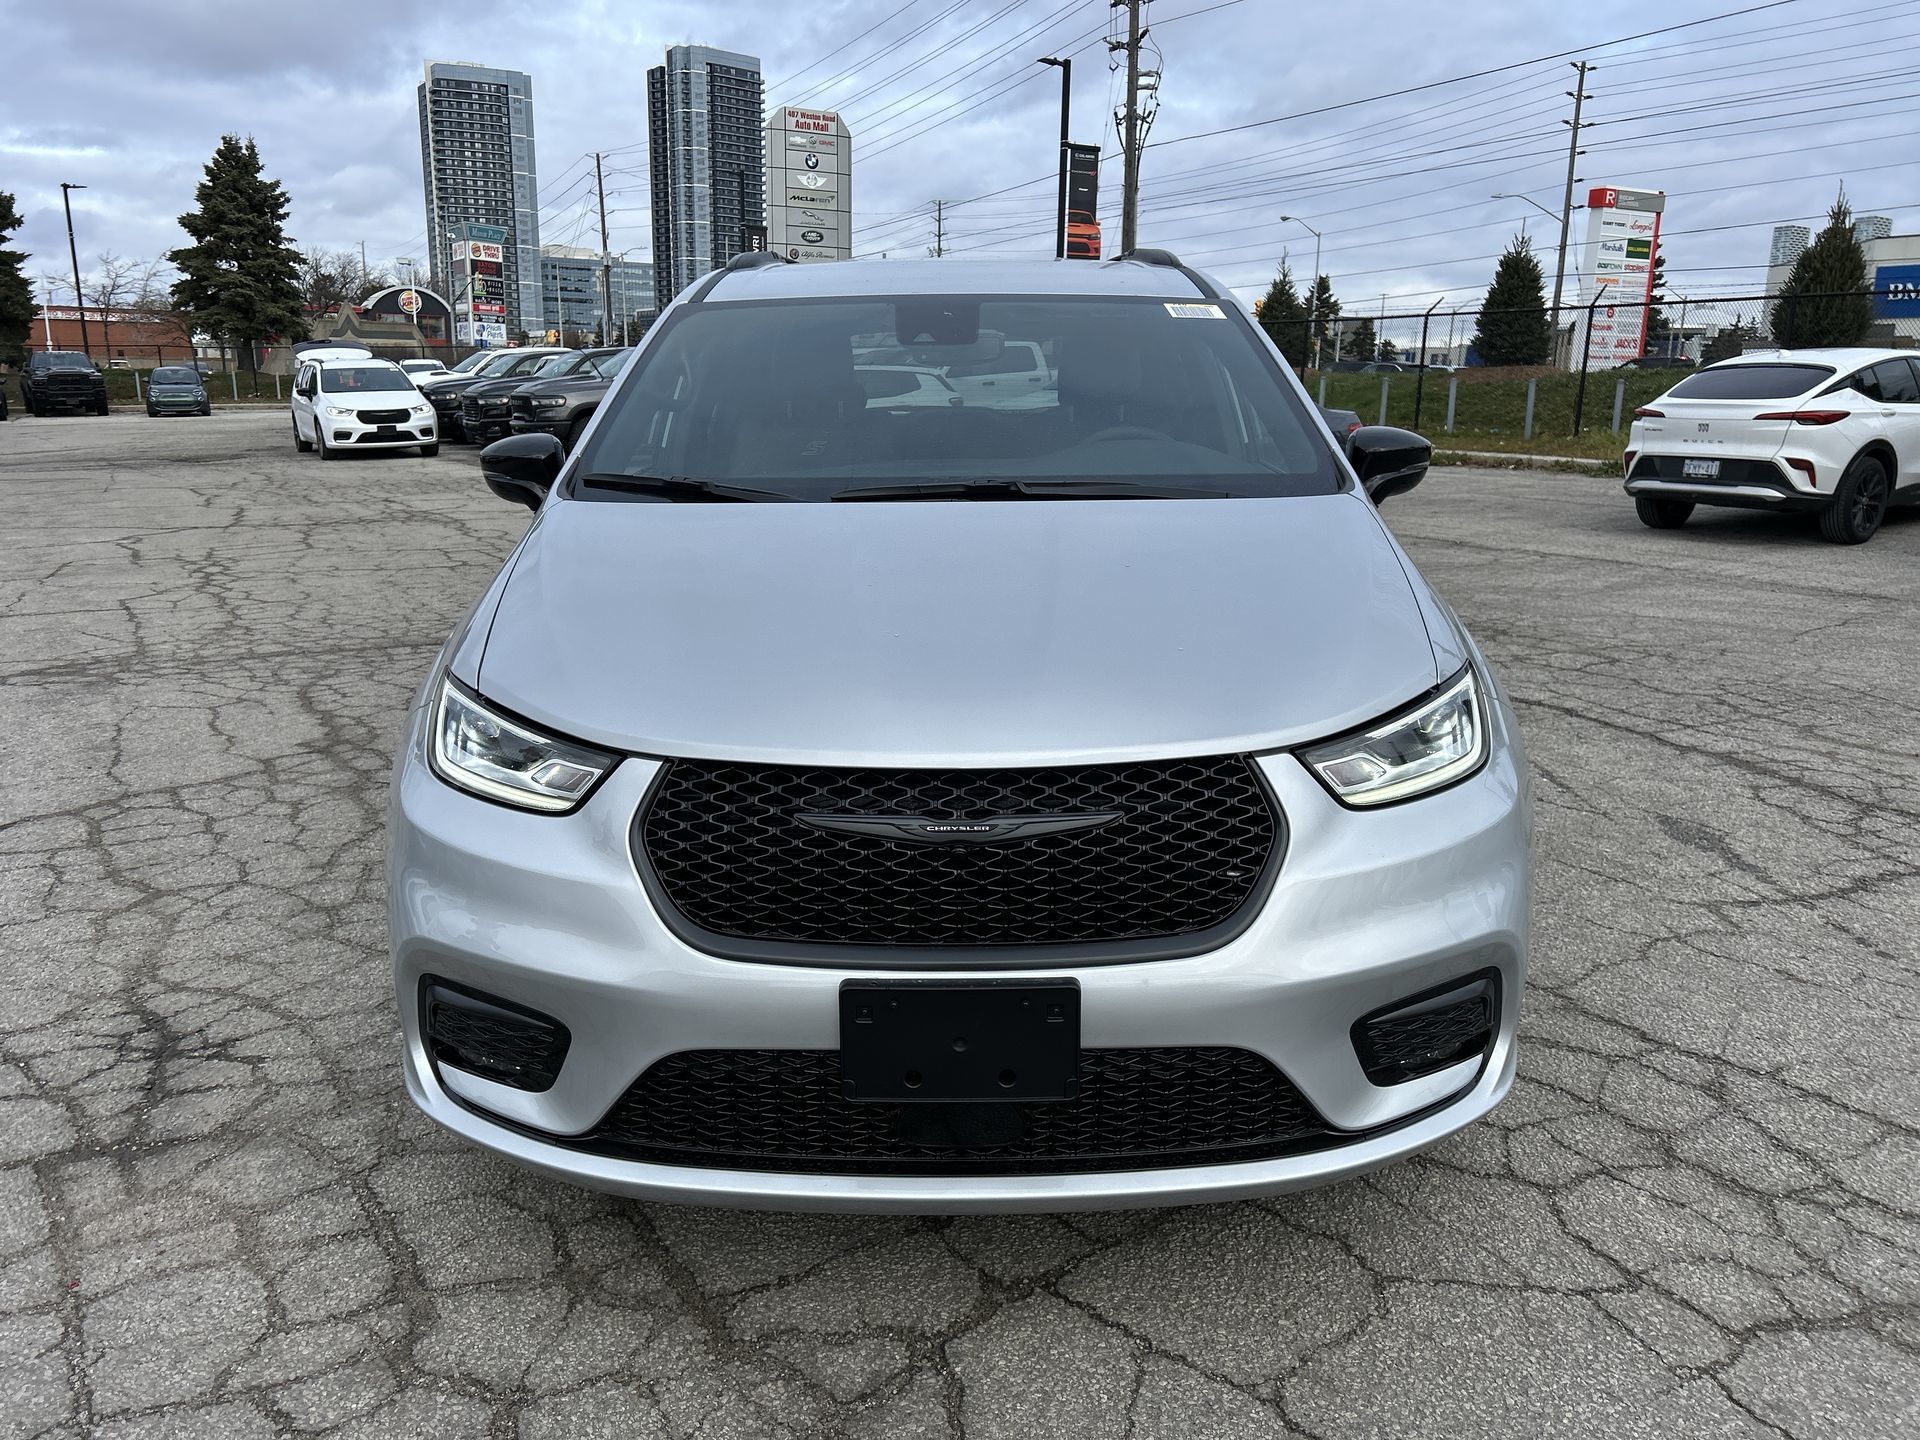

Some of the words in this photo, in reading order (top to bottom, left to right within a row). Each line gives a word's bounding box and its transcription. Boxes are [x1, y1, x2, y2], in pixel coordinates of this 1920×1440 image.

[800, 112, 821, 121] Weston
[795, 120, 811, 130] Auto
[813, 121, 829, 132] Mall
[1605, 190, 1615, 204] R
[482, 244, 501, 254] DRIVE
[484, 252, 500, 260] THRU
